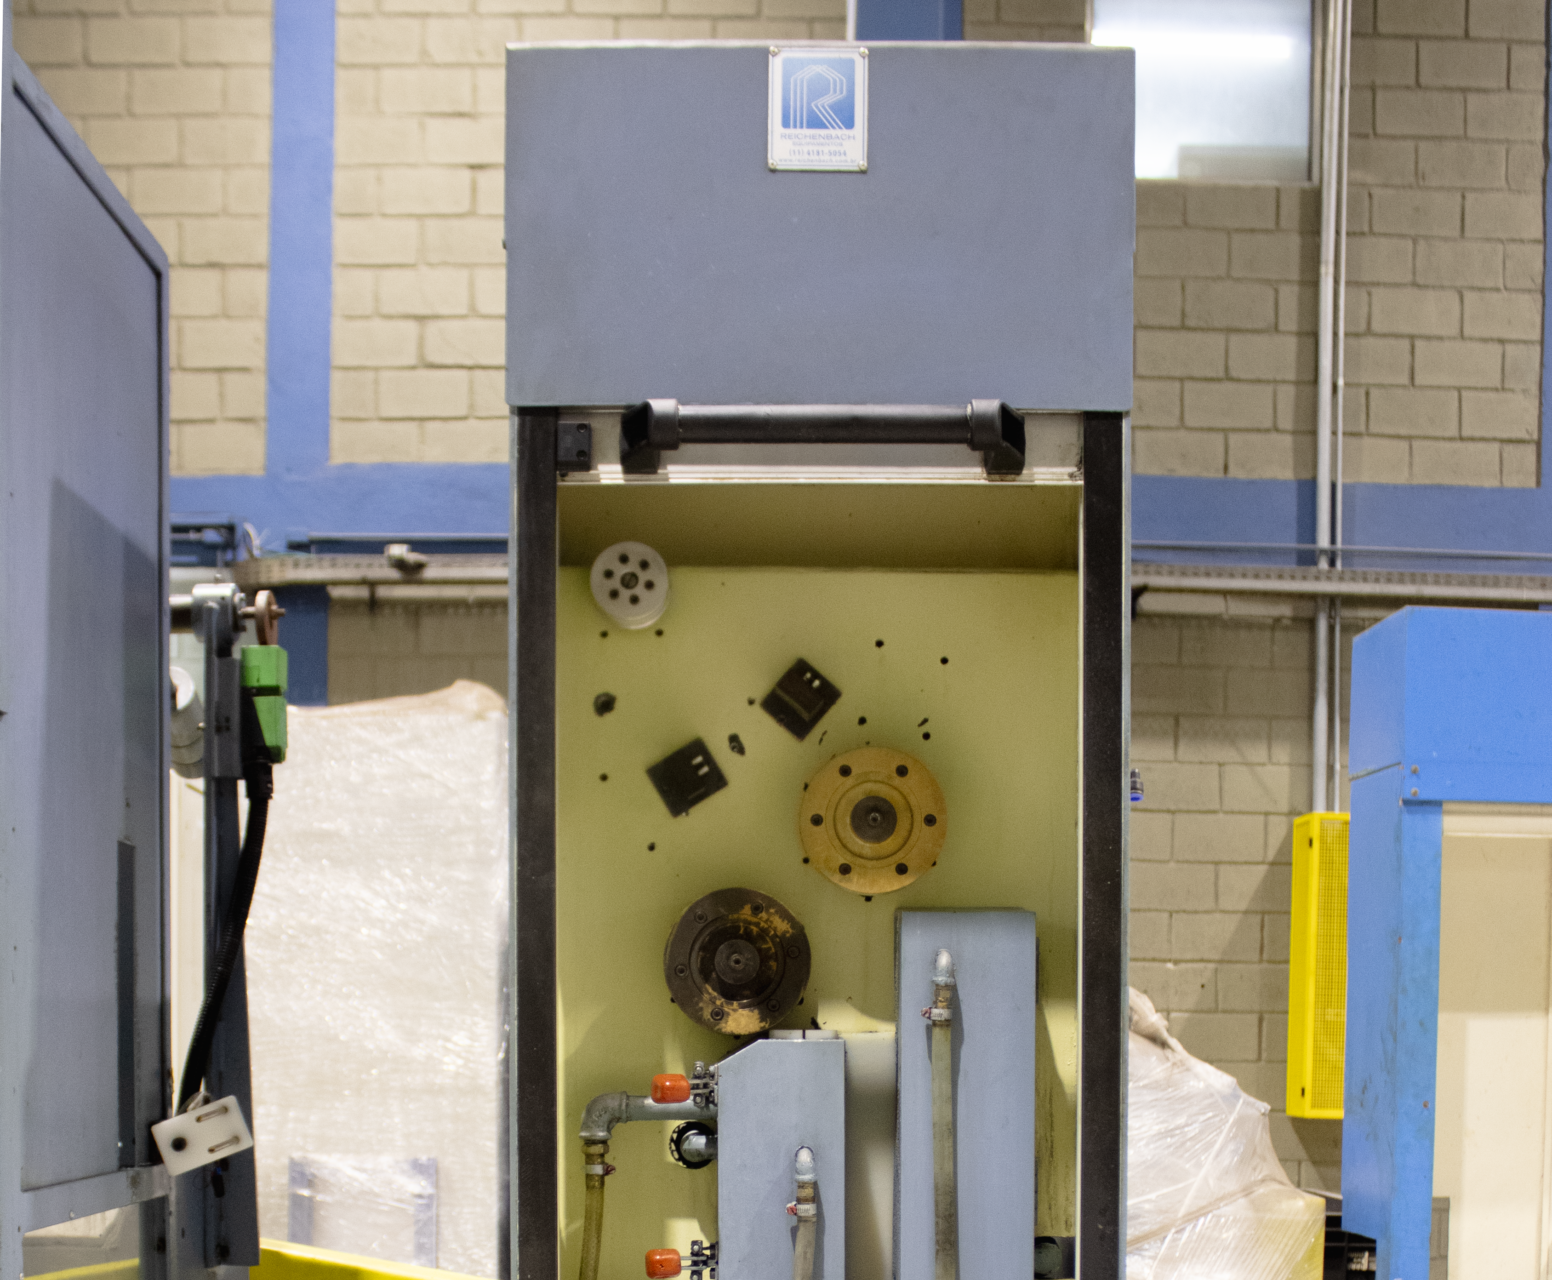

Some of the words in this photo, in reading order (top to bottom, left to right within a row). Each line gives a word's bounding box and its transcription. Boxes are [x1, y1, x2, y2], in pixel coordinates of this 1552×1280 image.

[780, 132, 856, 141] REICHENBACH
[789, 149, 805, 157] (11)
[806, 149, 847, 157] 4181-5054
